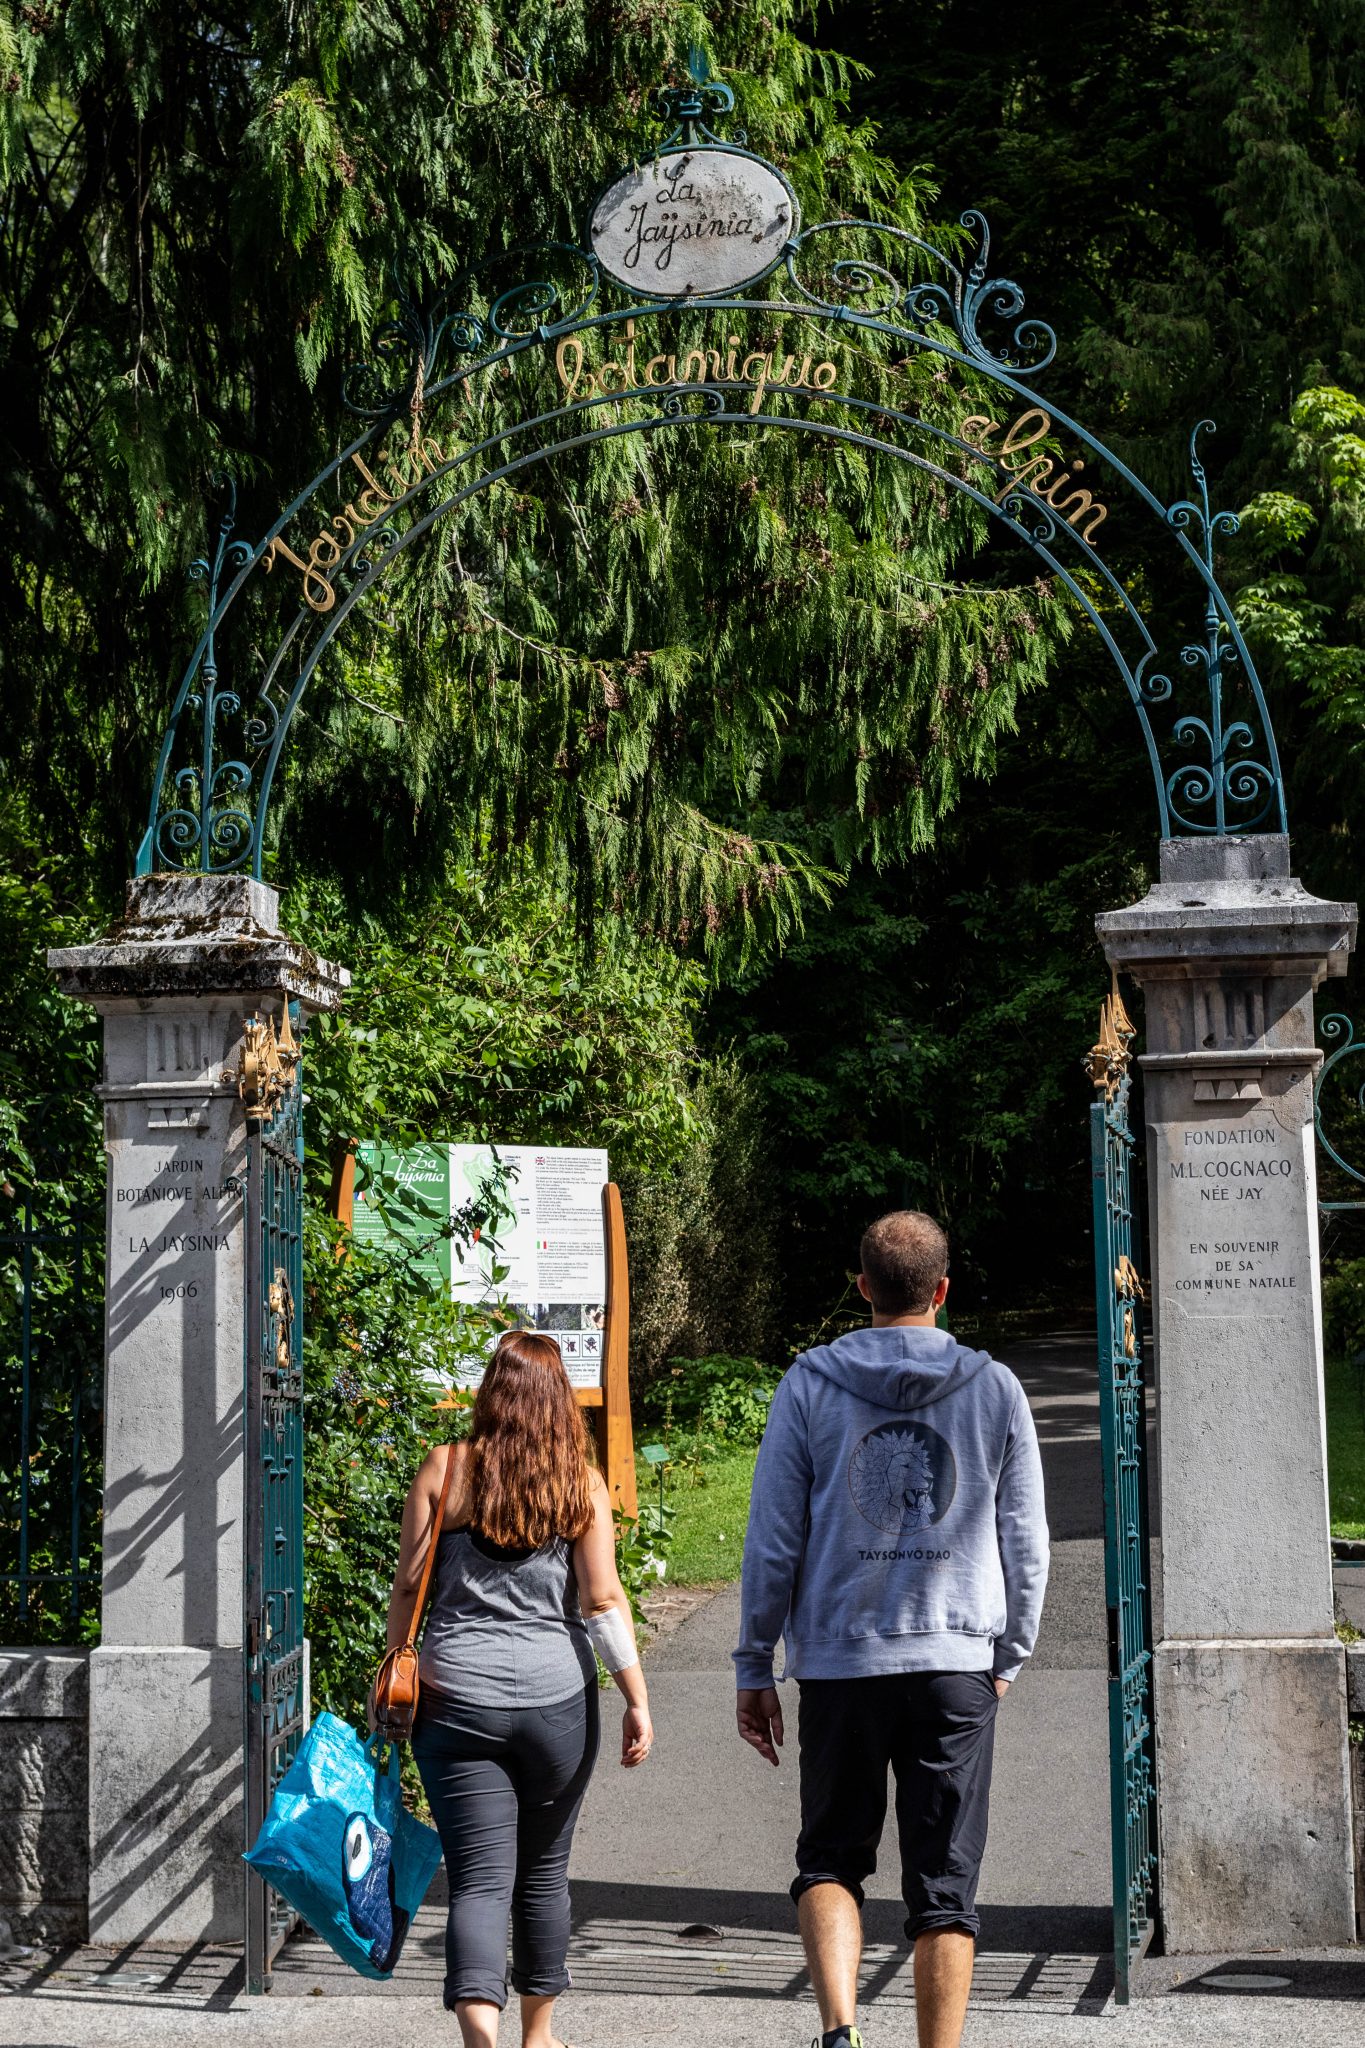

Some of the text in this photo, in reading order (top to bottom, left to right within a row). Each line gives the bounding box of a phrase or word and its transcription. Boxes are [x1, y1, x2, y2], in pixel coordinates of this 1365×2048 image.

[656, 164, 696, 203] La
[262, 437, 455, 612] Jardin
[1184, 1129, 1275, 1146] FONDATION
[408, 1146, 438, 1169] La
[154, 1160, 203, 1173] JARDIN
[1200, 1184, 1263, 1201] NÉE JAY
[130, 1235, 230, 1252] LA JAYSINIA
[1190, 1241, 1279, 1254] EN SOUVENIR
[1215, 1260, 1254, 1272] DE SA
[160, 1280, 198, 1304] 1906
[1175, 1277, 1296, 1290] COMMUNE NATALE
